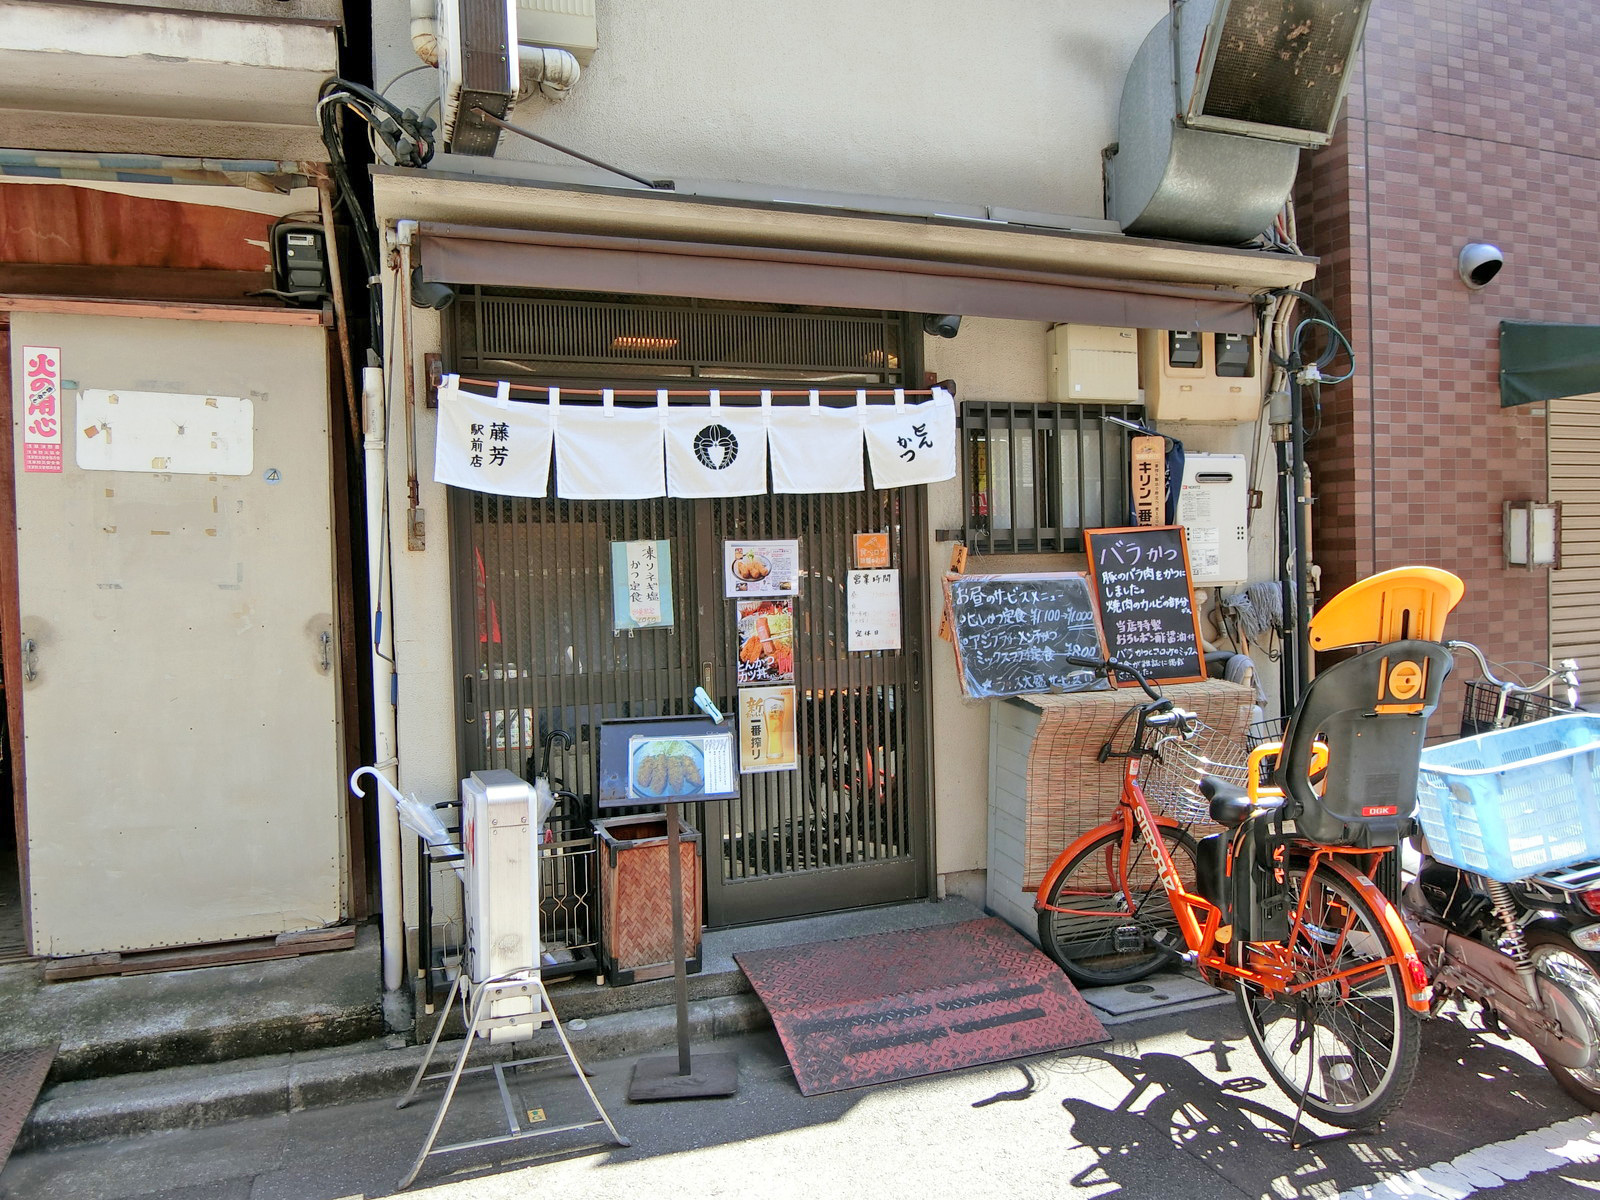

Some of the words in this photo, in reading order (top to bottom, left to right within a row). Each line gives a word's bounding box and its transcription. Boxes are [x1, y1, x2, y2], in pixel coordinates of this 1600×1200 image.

[28, 353, 57, 438] 火の用心
[470, 423, 485, 468] 駅前店
[489, 421, 510, 467] 藤芳
[1138, 461, 1152, 527] キリン一番
[1100, 540, 1178, 566] バラかつ
[630, 560, 643, 603] かつ定食
[853, 573, 891, 586] 営業時間
[1102, 566, 1186, 585] 豚のバラ肉をかつに
[956, 586, 1065, 608] お昼のサービスメニュー
[1105, 583, 1146, 599] しました。
[1105, 595, 1190, 614] 焼肉のカルビの部分
[855, 629, 880, 638] 定休日
[1115, 619, 1163, 633] 当店特製
[738, 656, 775, 672] とんかつ
[739, 668, 767, 683] カツ丼
[746, 697, 764, 713] 新
[751, 719, 761, 760] 一番搾り
